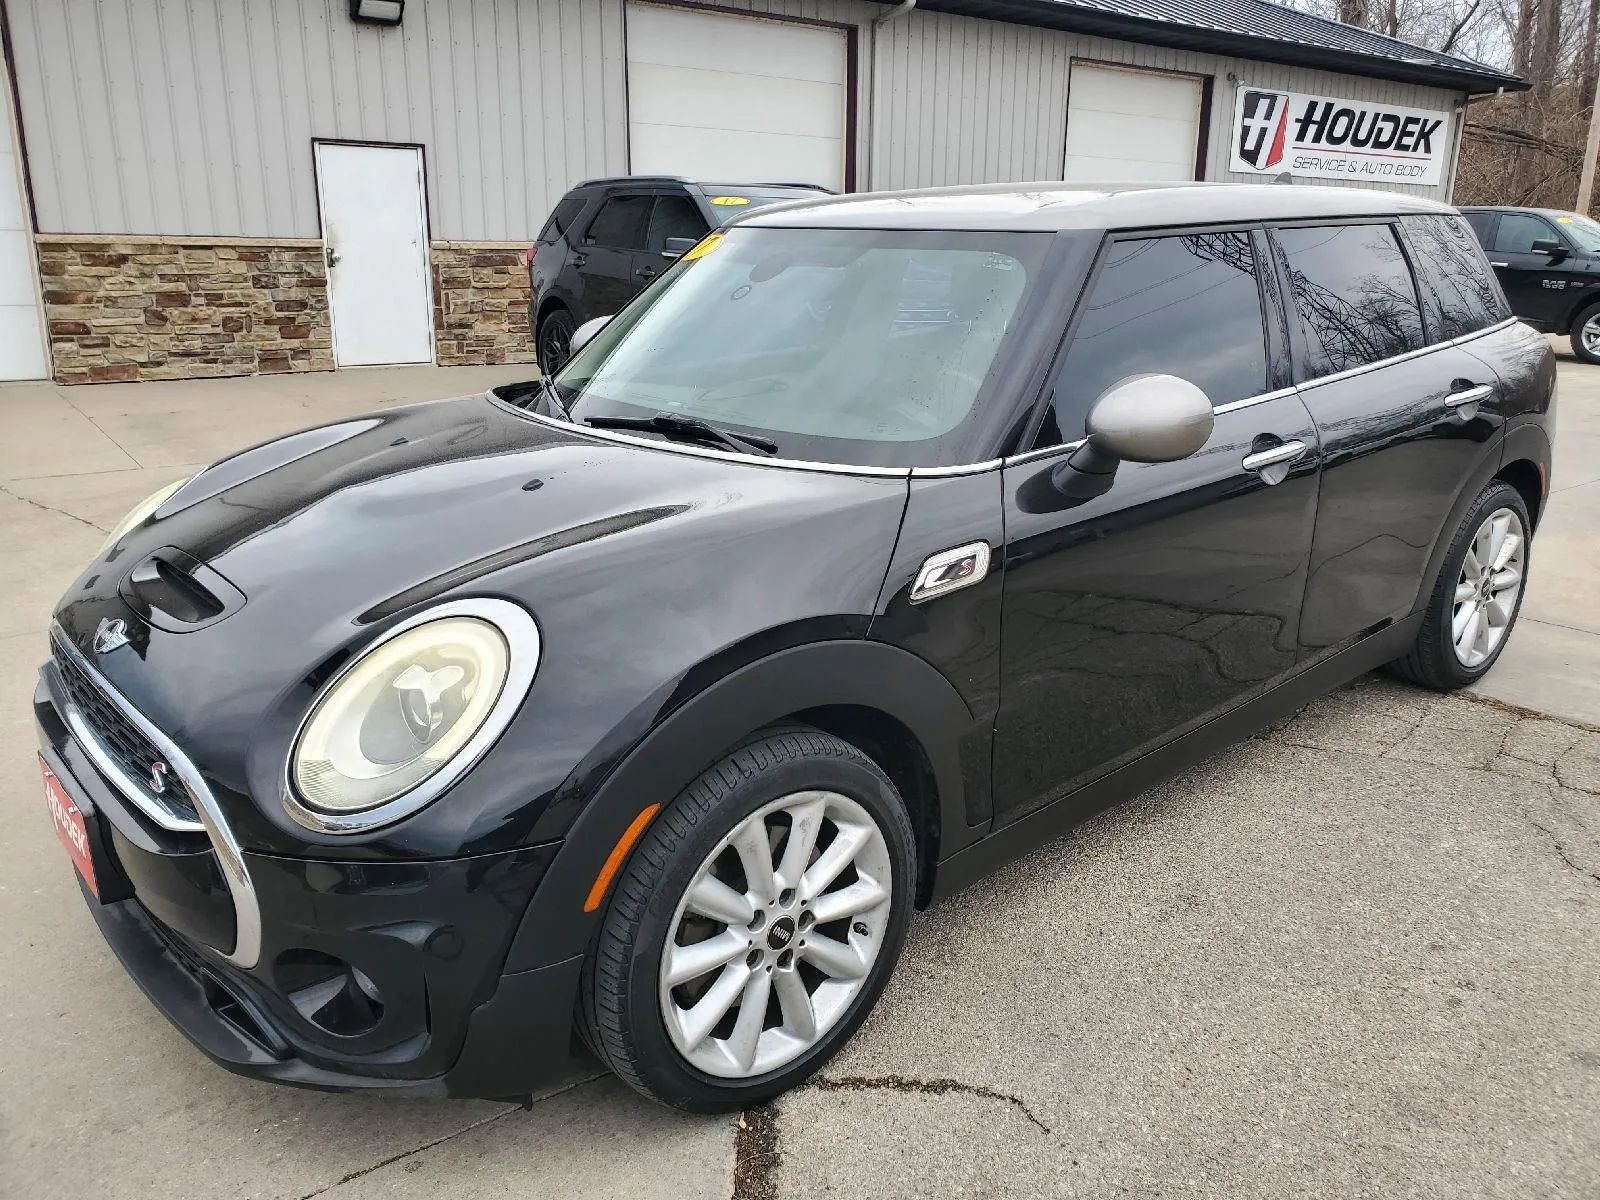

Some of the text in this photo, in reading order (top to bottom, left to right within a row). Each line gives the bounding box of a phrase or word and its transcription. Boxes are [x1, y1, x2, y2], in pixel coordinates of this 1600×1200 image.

[1294, 100, 1443, 154] HOUDEK
[1293, 156, 1428, 177] SERVICE & AUTO BODY
